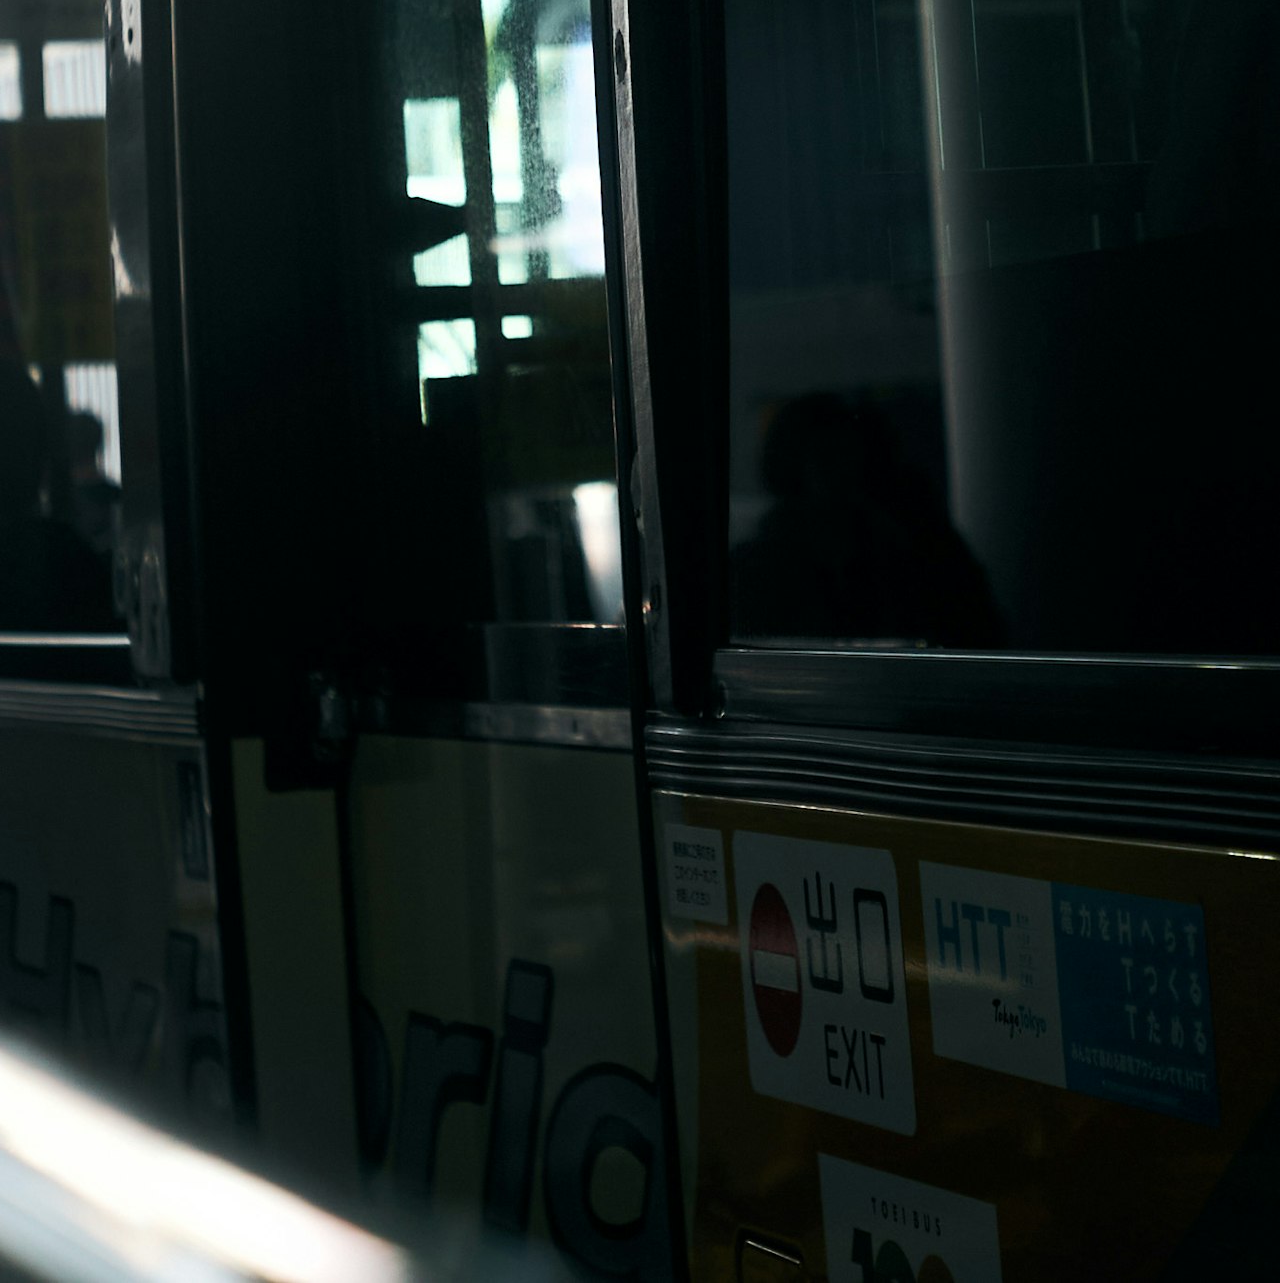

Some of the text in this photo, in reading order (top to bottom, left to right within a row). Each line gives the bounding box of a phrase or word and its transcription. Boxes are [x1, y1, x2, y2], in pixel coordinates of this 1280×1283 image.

[803, 871, 895, 1004] 出口
[934, 897, 1011, 982] HTT
[824, 1024, 886, 1100] EXIT
[870, 1196, 942, 1237] TOEI BUS
